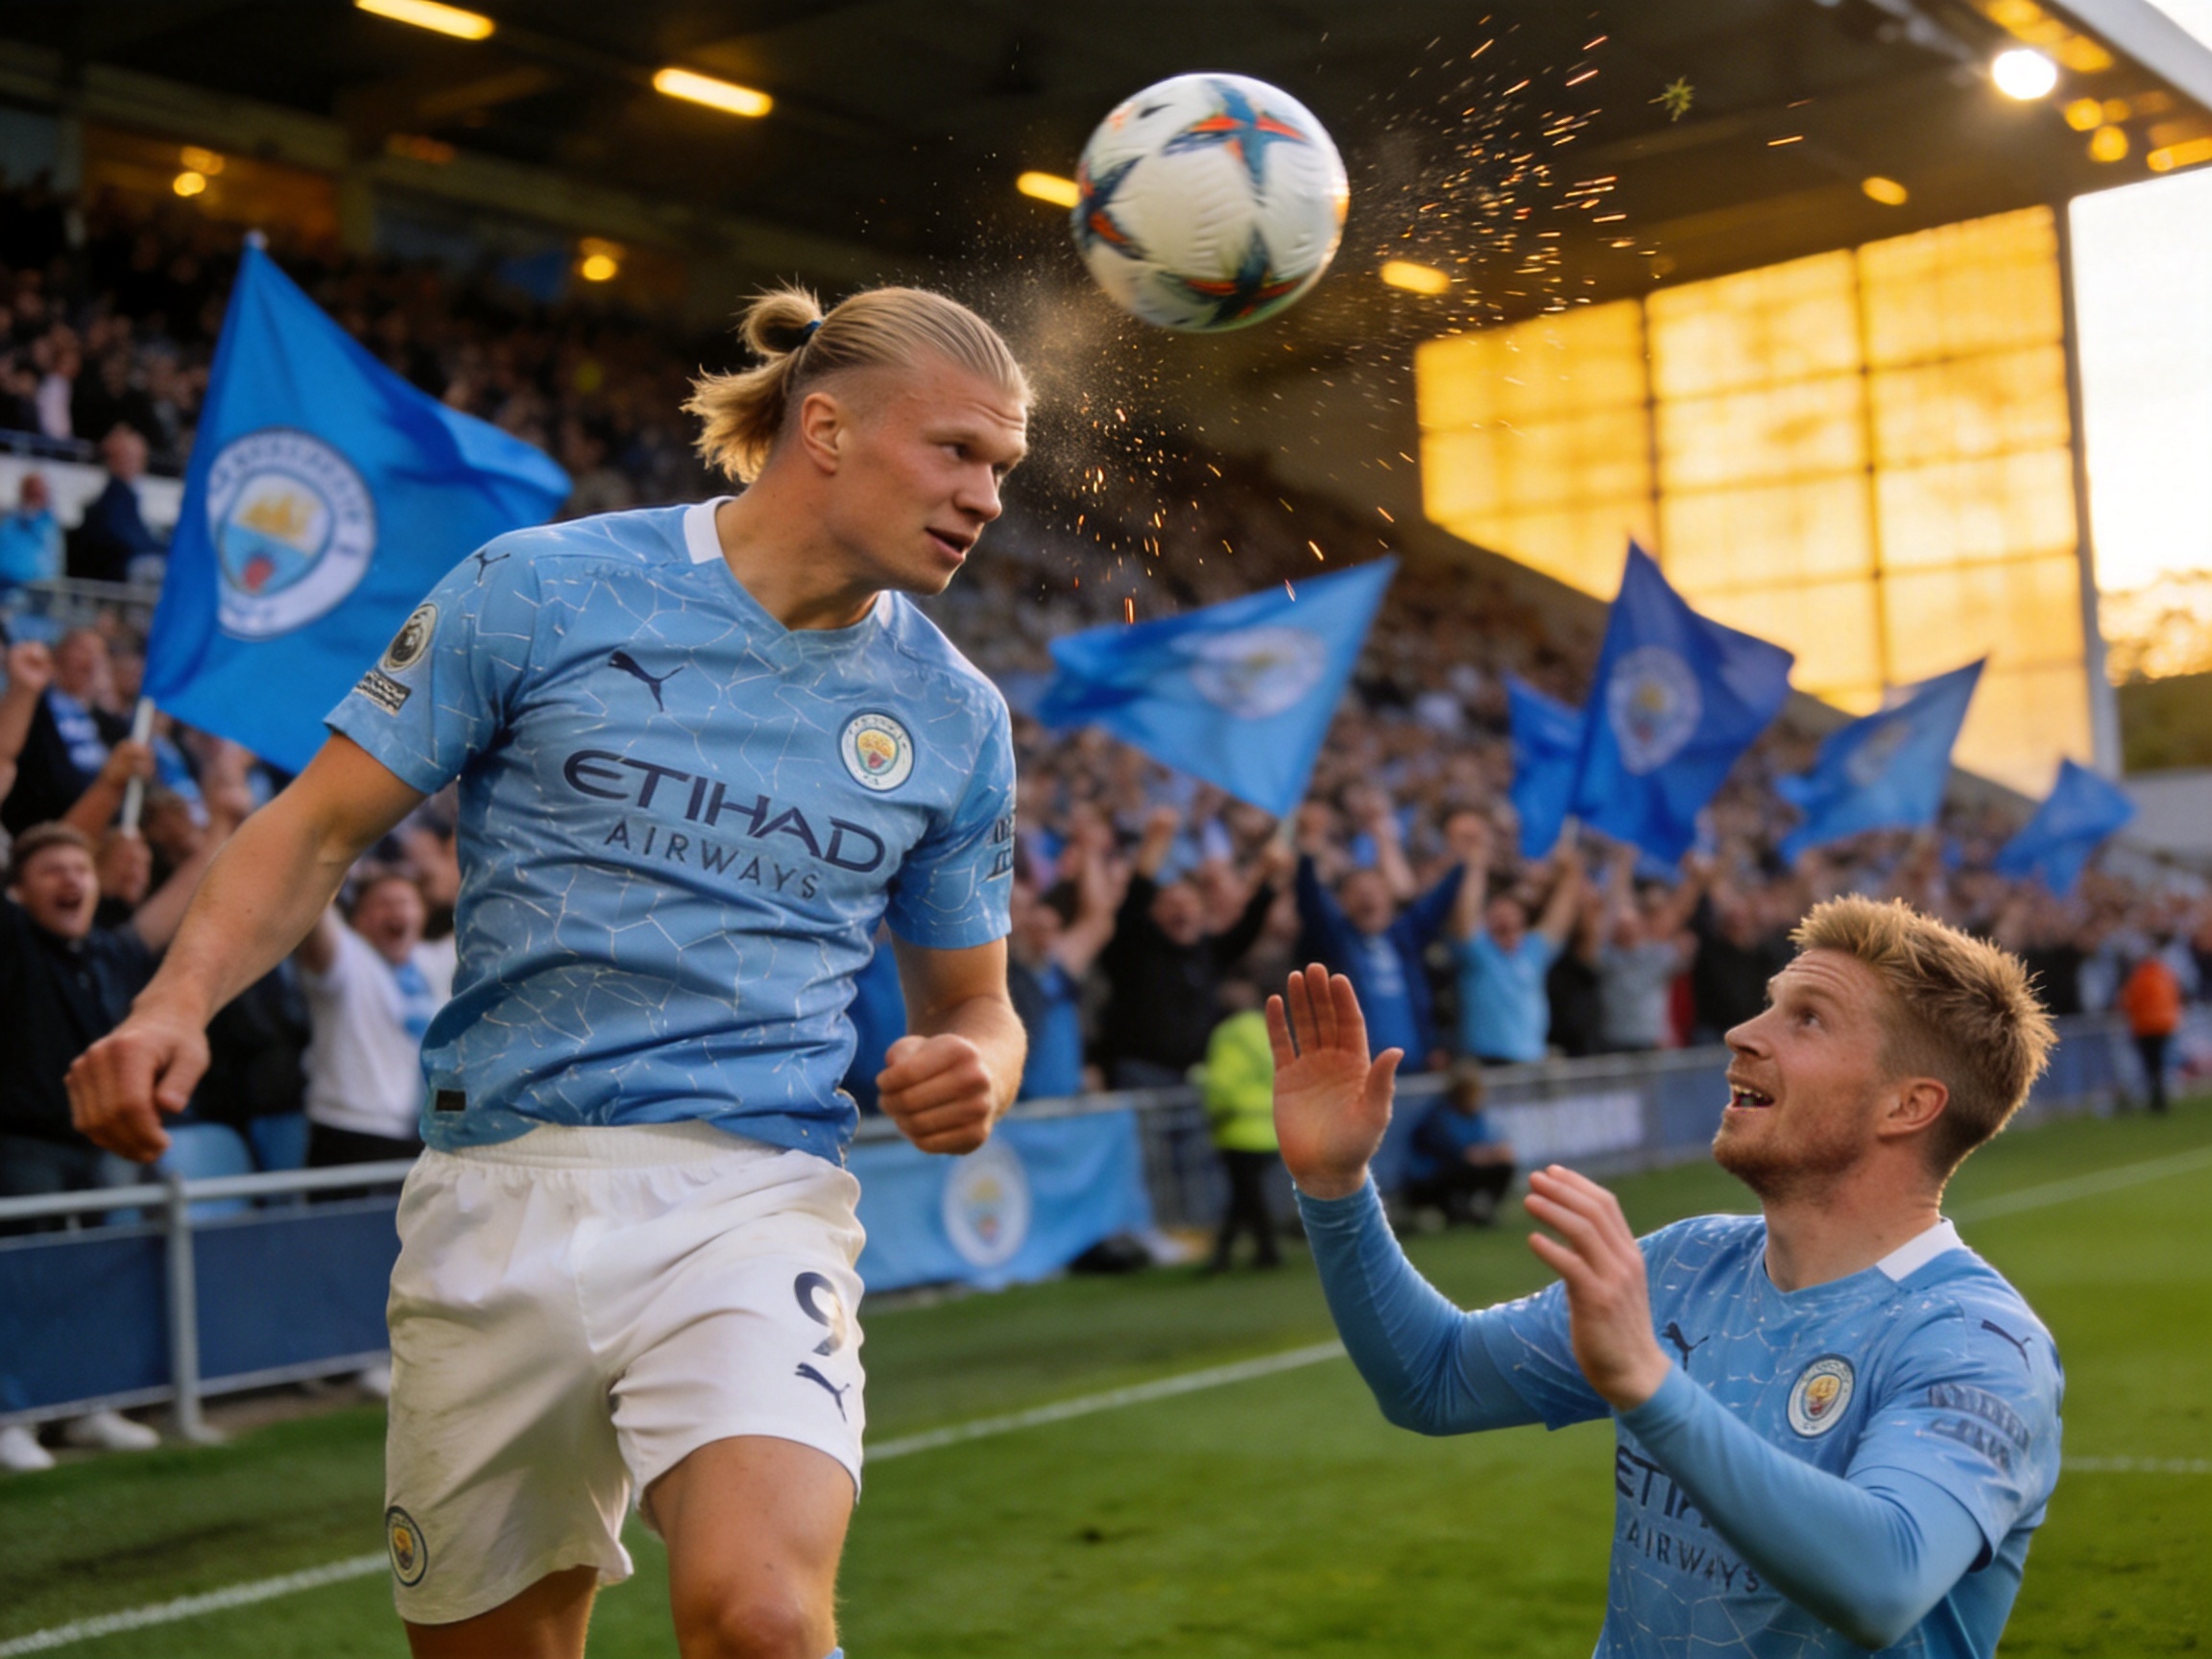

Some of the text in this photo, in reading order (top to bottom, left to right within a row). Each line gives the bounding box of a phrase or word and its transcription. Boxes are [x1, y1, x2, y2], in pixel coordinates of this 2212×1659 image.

[564, 750, 885, 873] ETIHAD
[604, 820, 821, 900] AIRWAYS
[1615, 1445, 1709, 1528] ETI
[1626, 1519, 1760, 1593] AIRWAYS
